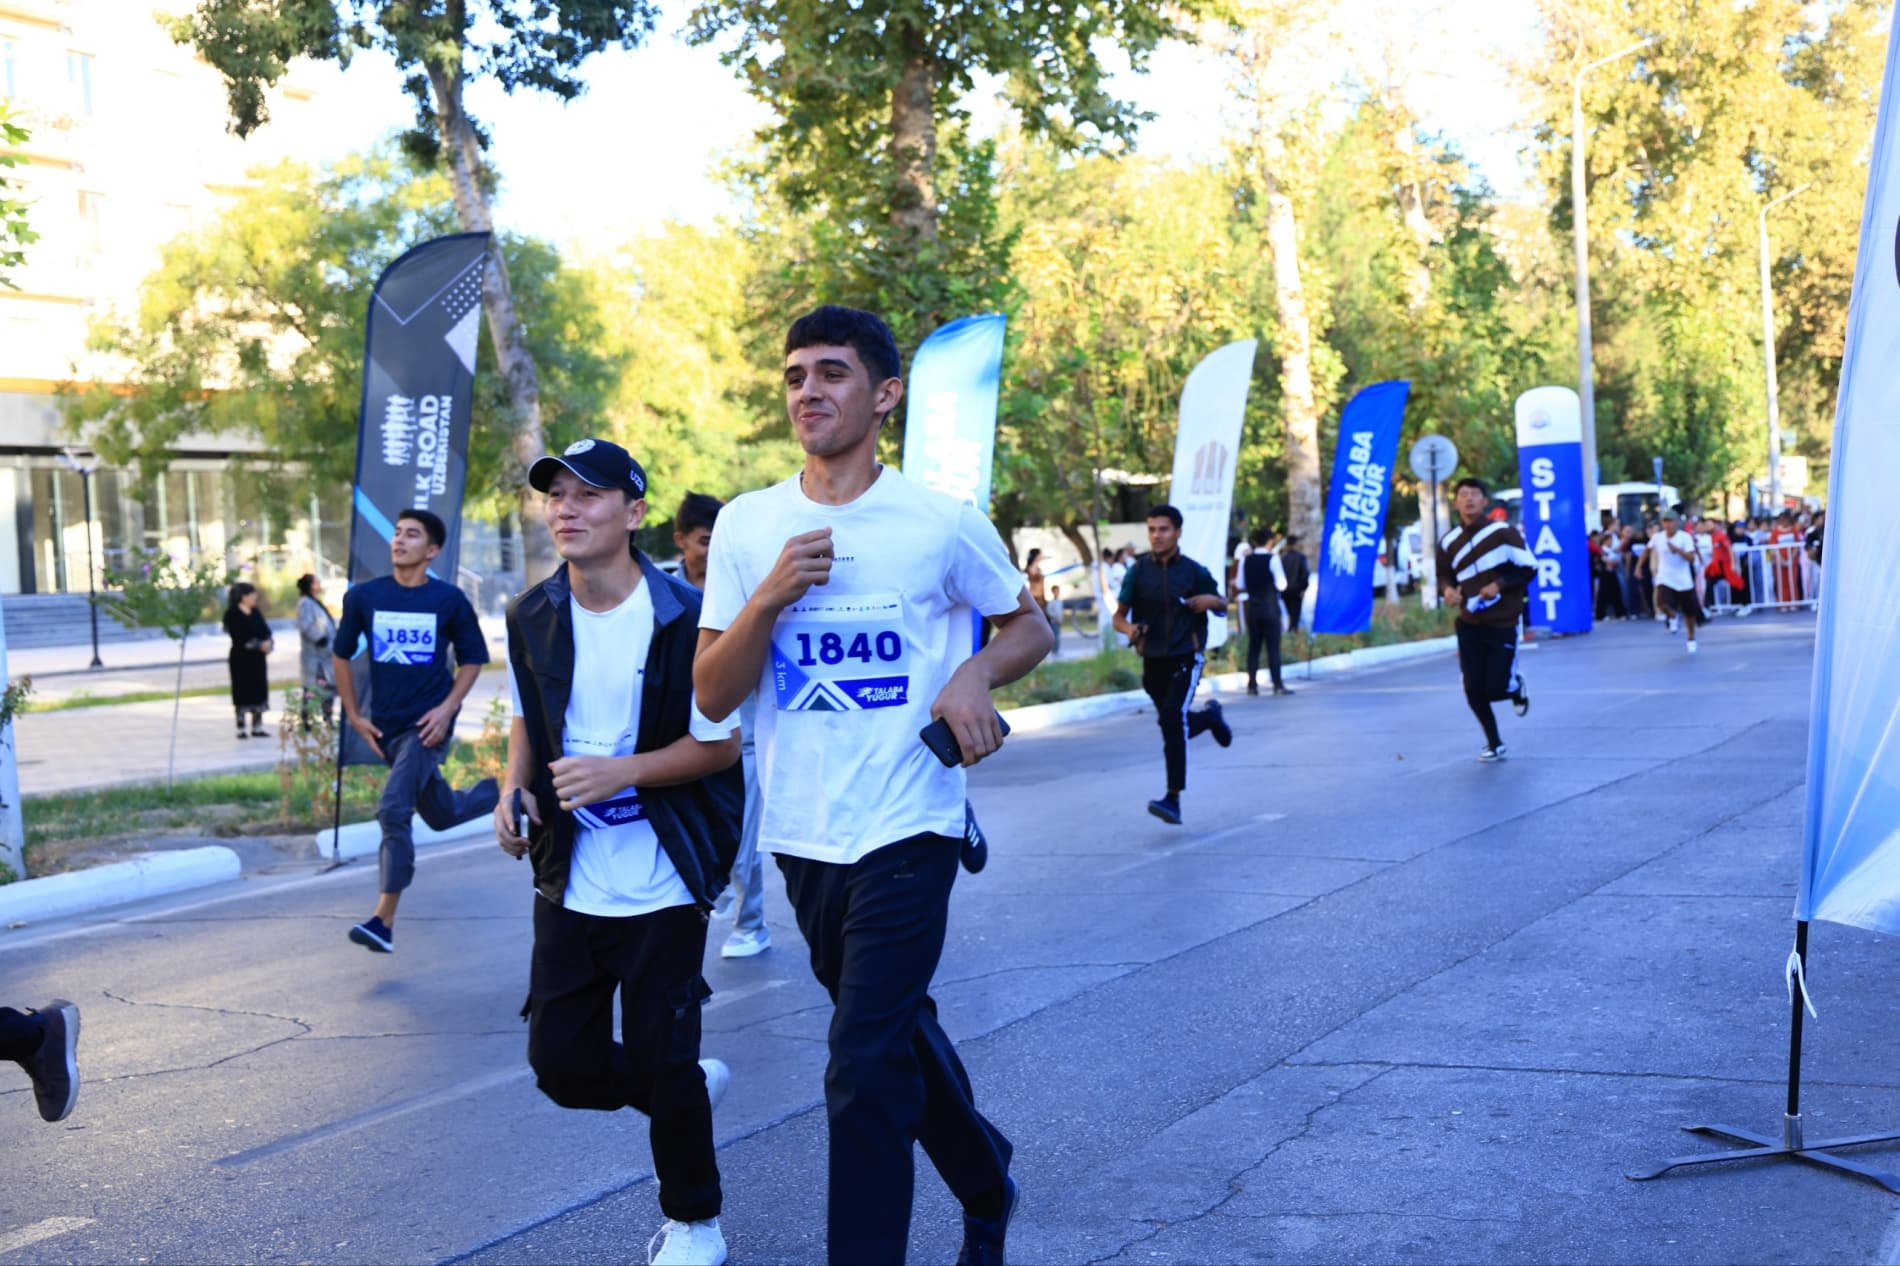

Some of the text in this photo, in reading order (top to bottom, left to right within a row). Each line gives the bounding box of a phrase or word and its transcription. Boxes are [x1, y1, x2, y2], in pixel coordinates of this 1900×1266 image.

[413, 395, 439, 510] ILK ROAD
[431, 395, 452, 495] UZBEKISTAN
[1339, 431, 1374, 521] TALABA
[1353, 463, 1386, 547] YUGUR
[1531, 457, 1563, 621] START
[386, 629, 432, 645] 1836
[796, 631, 902, 666] 1840
[776, 661, 788, 691] 3 km
[866, 692, 897, 702] YUGUR
[874, 686, 904, 696] TALABA
